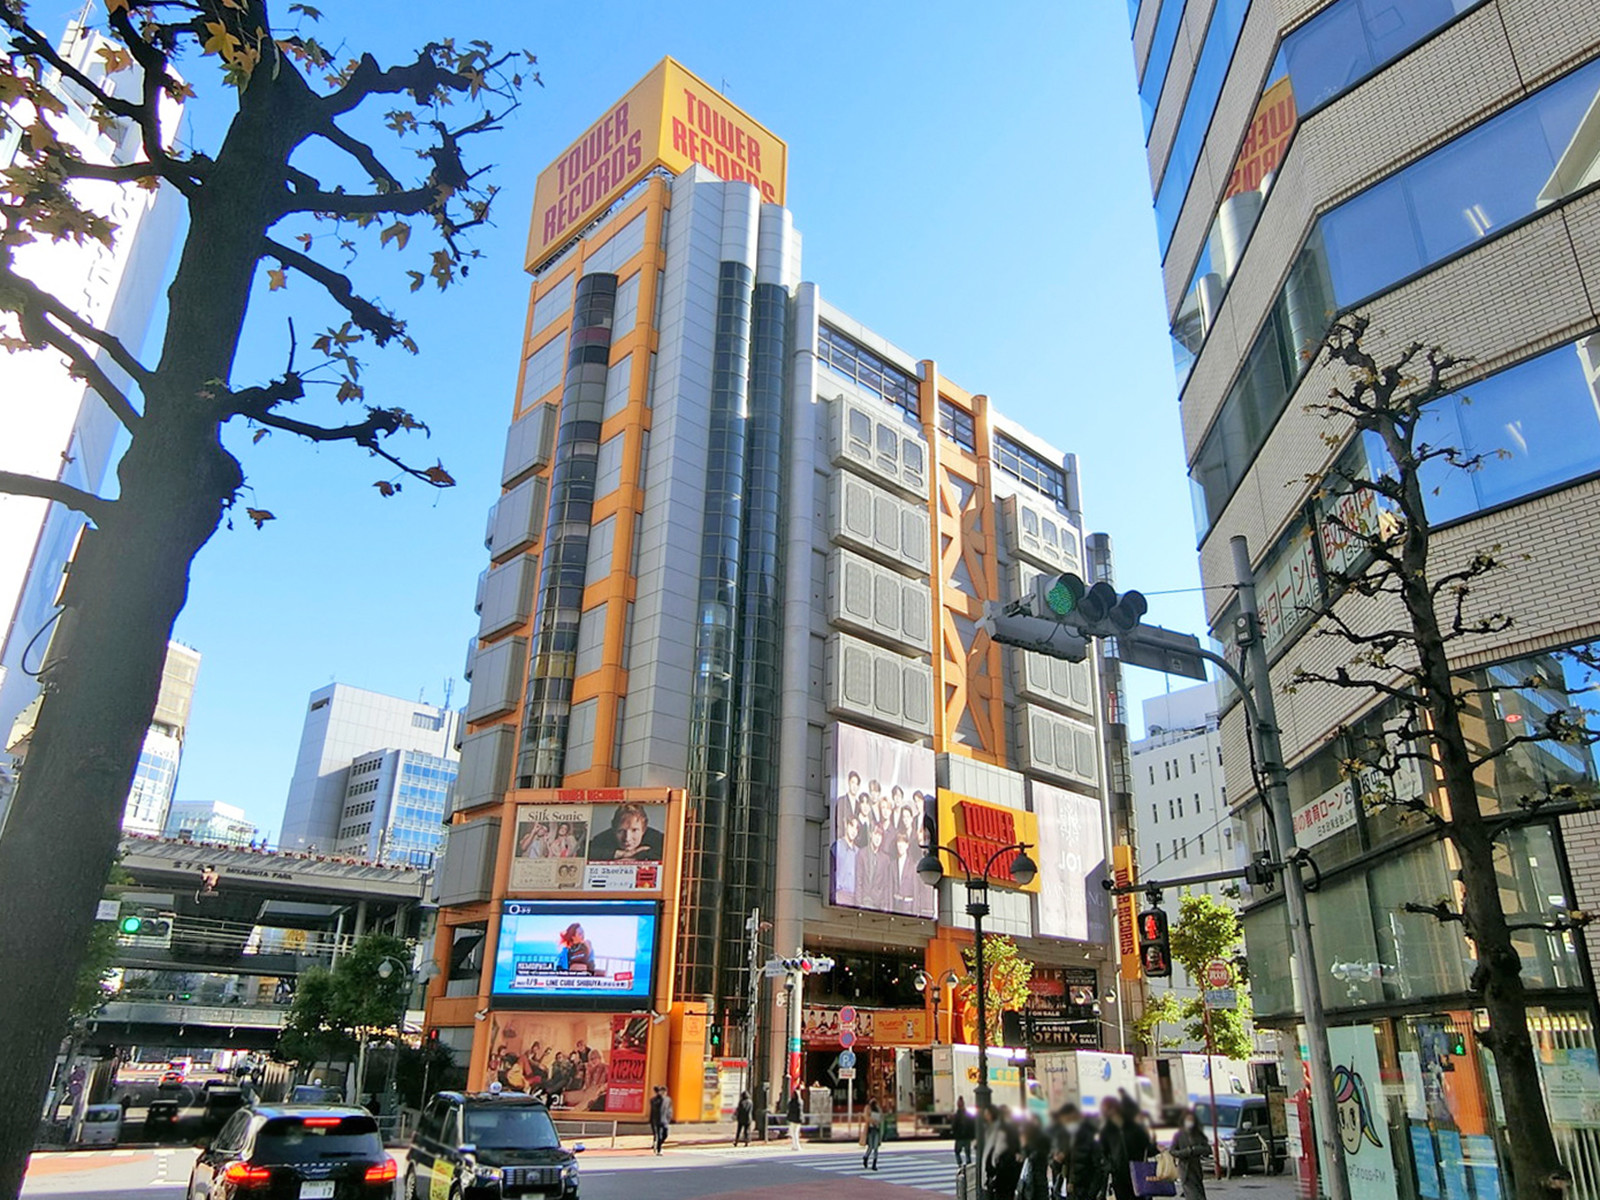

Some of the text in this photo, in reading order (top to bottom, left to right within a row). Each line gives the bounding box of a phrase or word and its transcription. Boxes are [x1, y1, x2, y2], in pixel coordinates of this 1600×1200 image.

[557, 101, 630, 195] TOWER
[684, 88, 762, 174] TOWER
[543, 129, 642, 247] RECORDS
[528, 809, 583, 821] Silk Sonic
[960, 800, 1016, 845] TOWER
[1118, 906, 1134, 956] RECORDS
